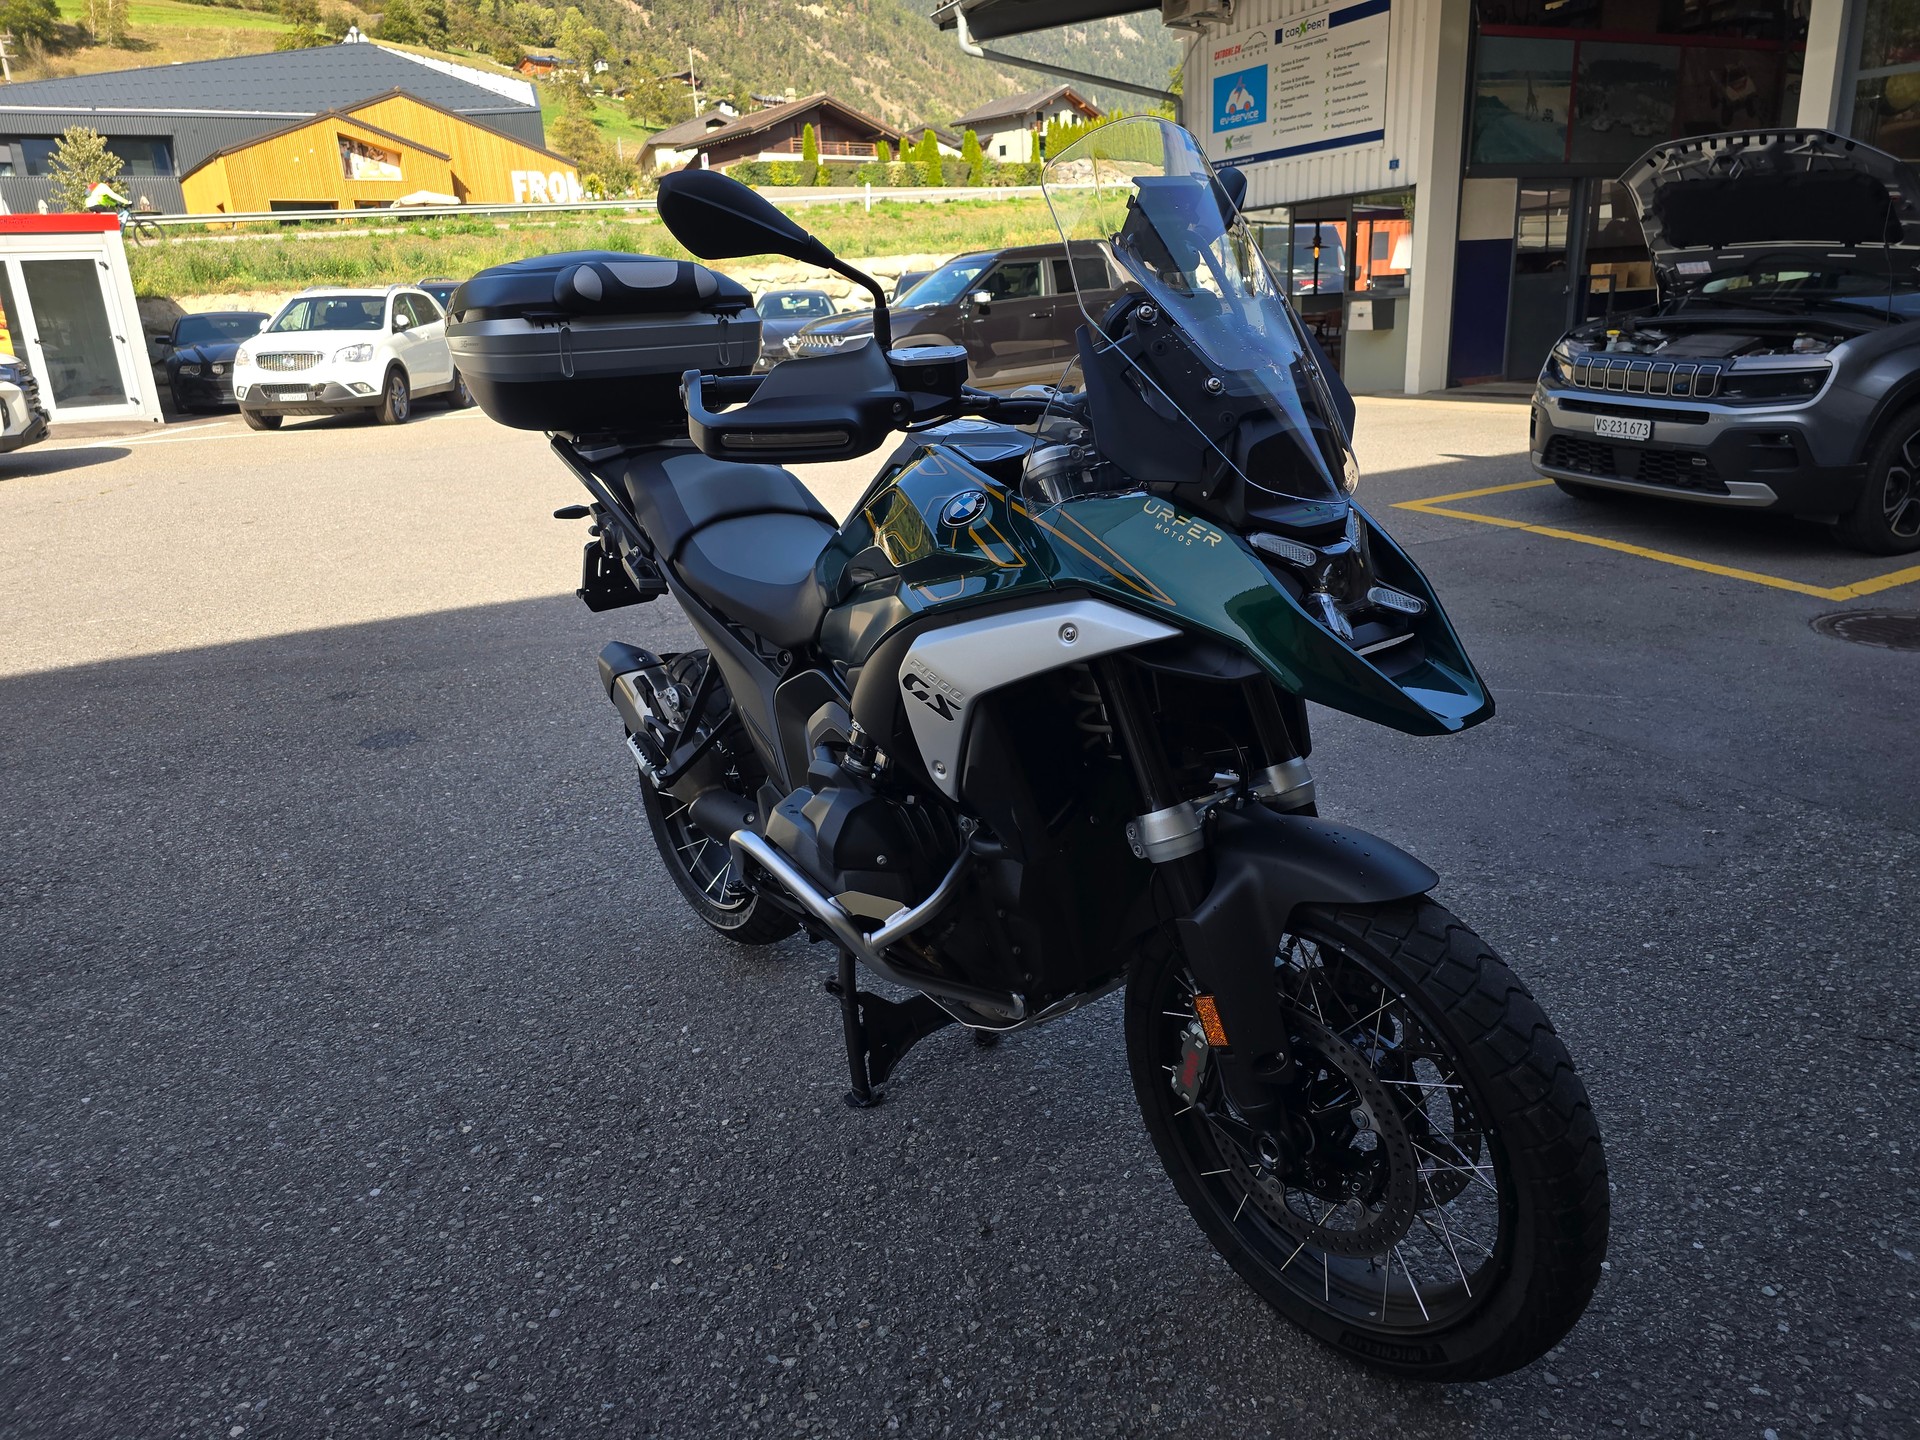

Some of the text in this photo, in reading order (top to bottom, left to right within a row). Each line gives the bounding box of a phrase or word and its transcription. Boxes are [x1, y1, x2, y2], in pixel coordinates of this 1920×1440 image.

[1143, 500, 1222, 547] URFER
[1154, 523, 1192, 546] MOTOS
[902, 673, 962, 721] GS
[910, 659, 965, 702] R1300
[1343, 1333, 1422, 1361] MICHELIN
